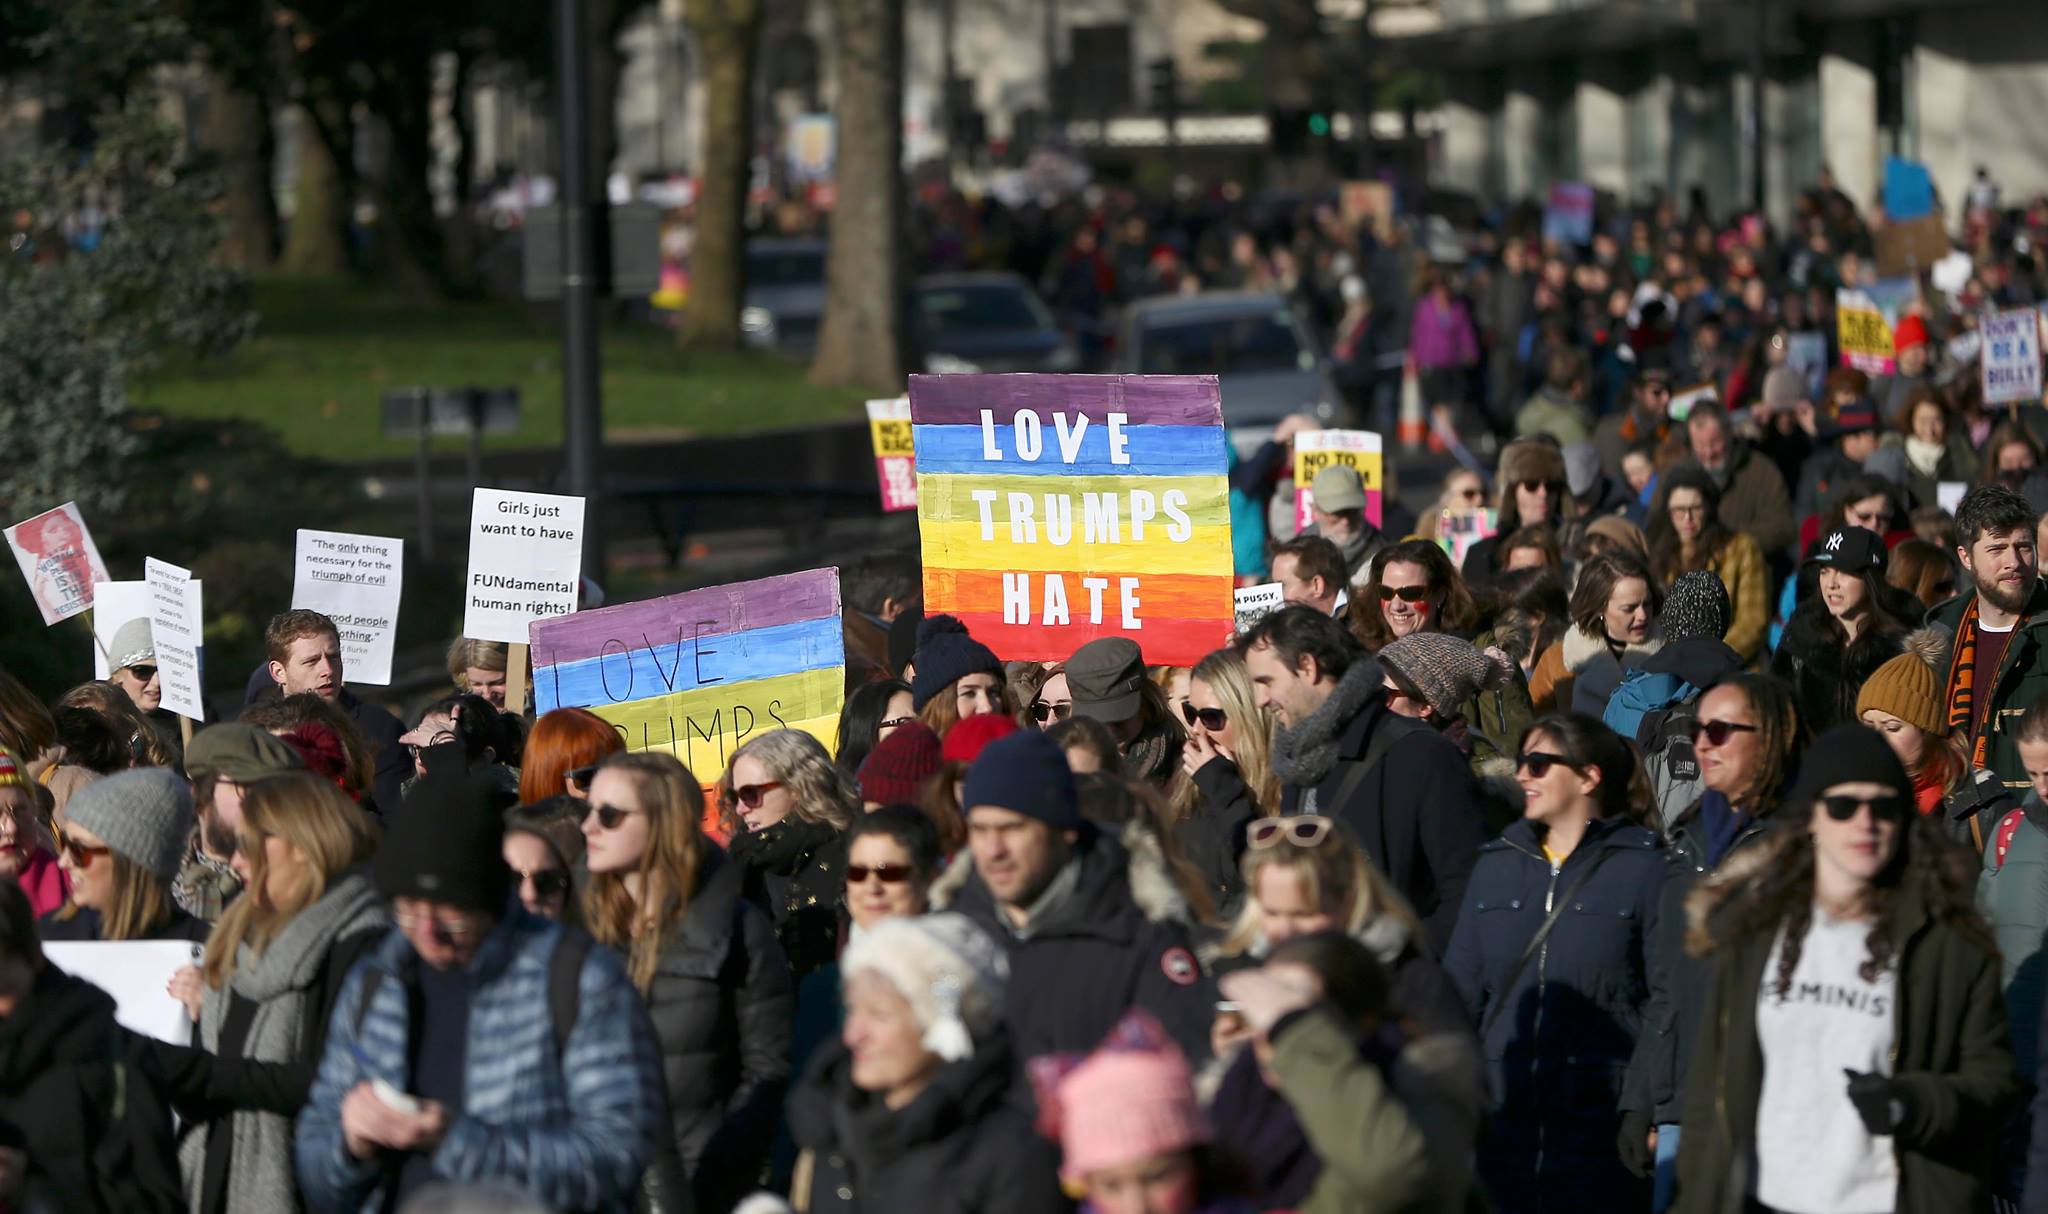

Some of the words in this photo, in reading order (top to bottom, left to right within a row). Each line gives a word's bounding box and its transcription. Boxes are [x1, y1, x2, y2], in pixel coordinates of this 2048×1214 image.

[882, 436, 914, 451] RAC
[980, 408, 1130, 464] LOVE
[1303, 453, 1327, 466] NO
[1334, 452, 1356, 466] TO
[498, 501, 529, 515] Girls
[532, 503, 560, 518] just
[971, 489, 1193, 546] TRUMPS
[480, 523, 516, 536] want
[520, 525, 536, 538] to
[540, 525, 574, 540] have
[337, 543, 360, 554] only
[362, 545, 389, 558] thing
[306, 554, 356, 569] necessary
[358, 559, 373, 568] for
[375, 561, 392, 571] the
[311, 570, 352, 583] triumph
[354, 573, 365, 583] of
[368, 576, 386, 585] evil
[473, 574, 573, 594] FUNdamental
[472, 596, 521, 612] human
[525, 601, 571, 616] rights!
[1002, 573, 1143, 630] HATE
[1243, 592, 1278, 604] PUSSY,
[353, 616, 389, 628] people
[339, 630, 380, 643] othing."
[552, 619, 724, 710] LOVE
